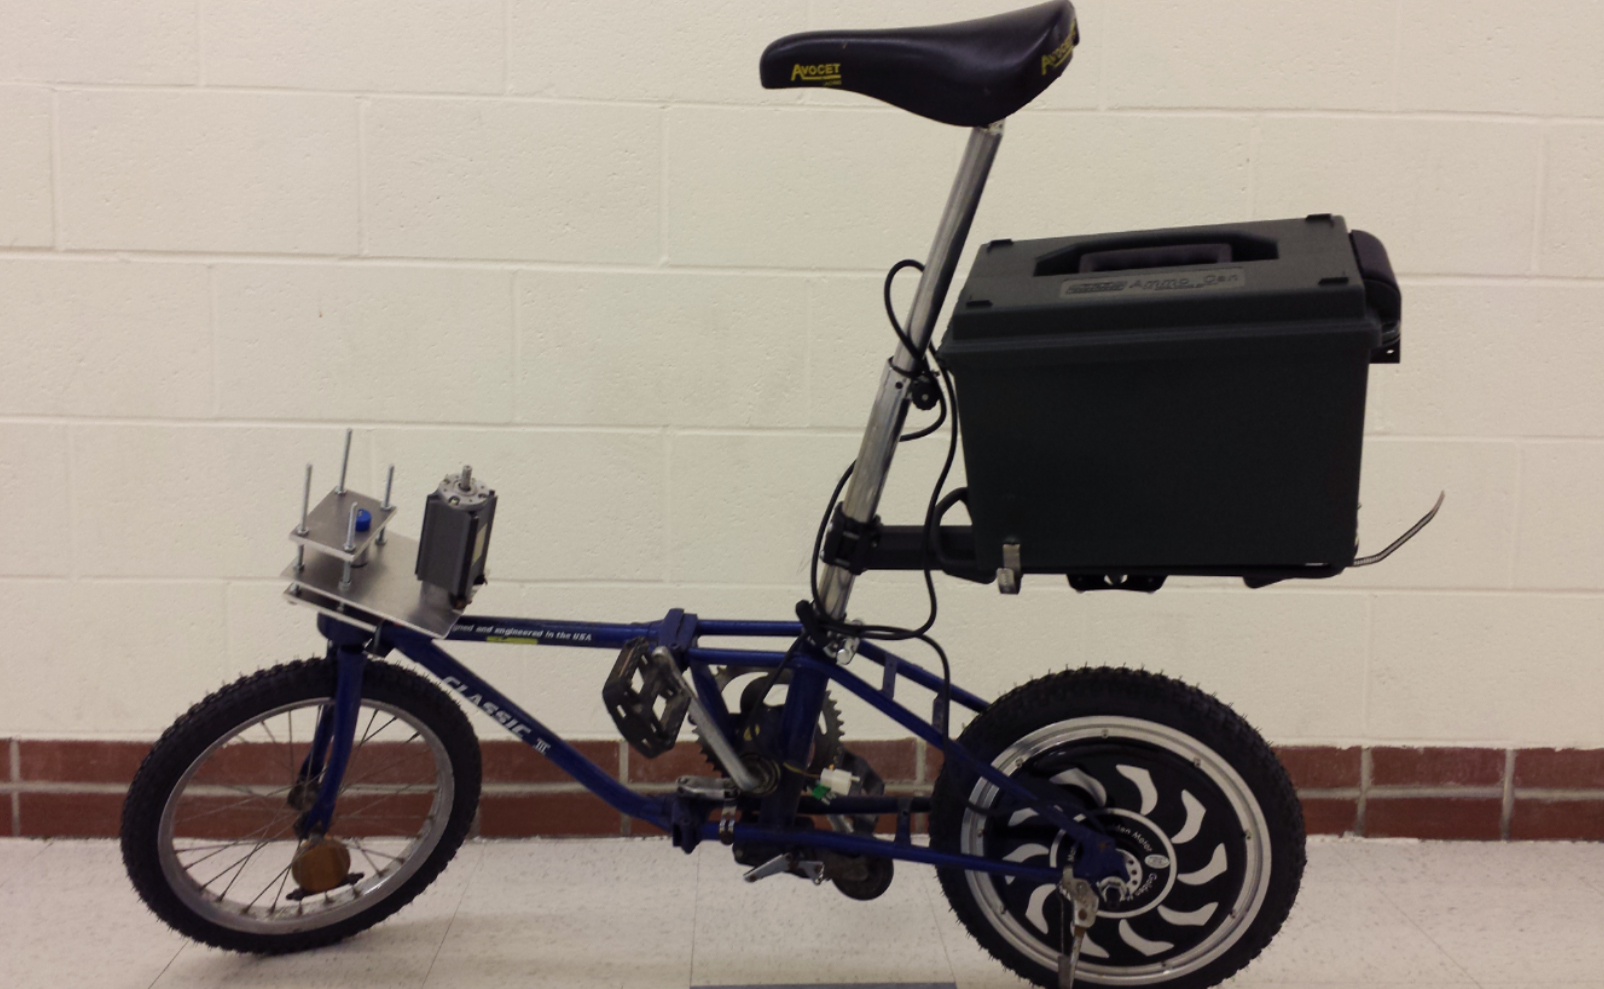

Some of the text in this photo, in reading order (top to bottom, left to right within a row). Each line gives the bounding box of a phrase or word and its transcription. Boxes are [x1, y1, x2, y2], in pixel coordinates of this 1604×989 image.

[790, 63, 842, 81] AVOCET
[1128, 277, 1190, 291] Ammo
[476, 626, 494, 634] and
[494, 627, 543, 638] engineered
[545, 629, 555, 639] in
[556, 631, 571, 640] the
[572, 633, 592, 641] USA
[442, 675, 532, 738] CLASSIC
[1131, 830, 1154, 853] Motor
